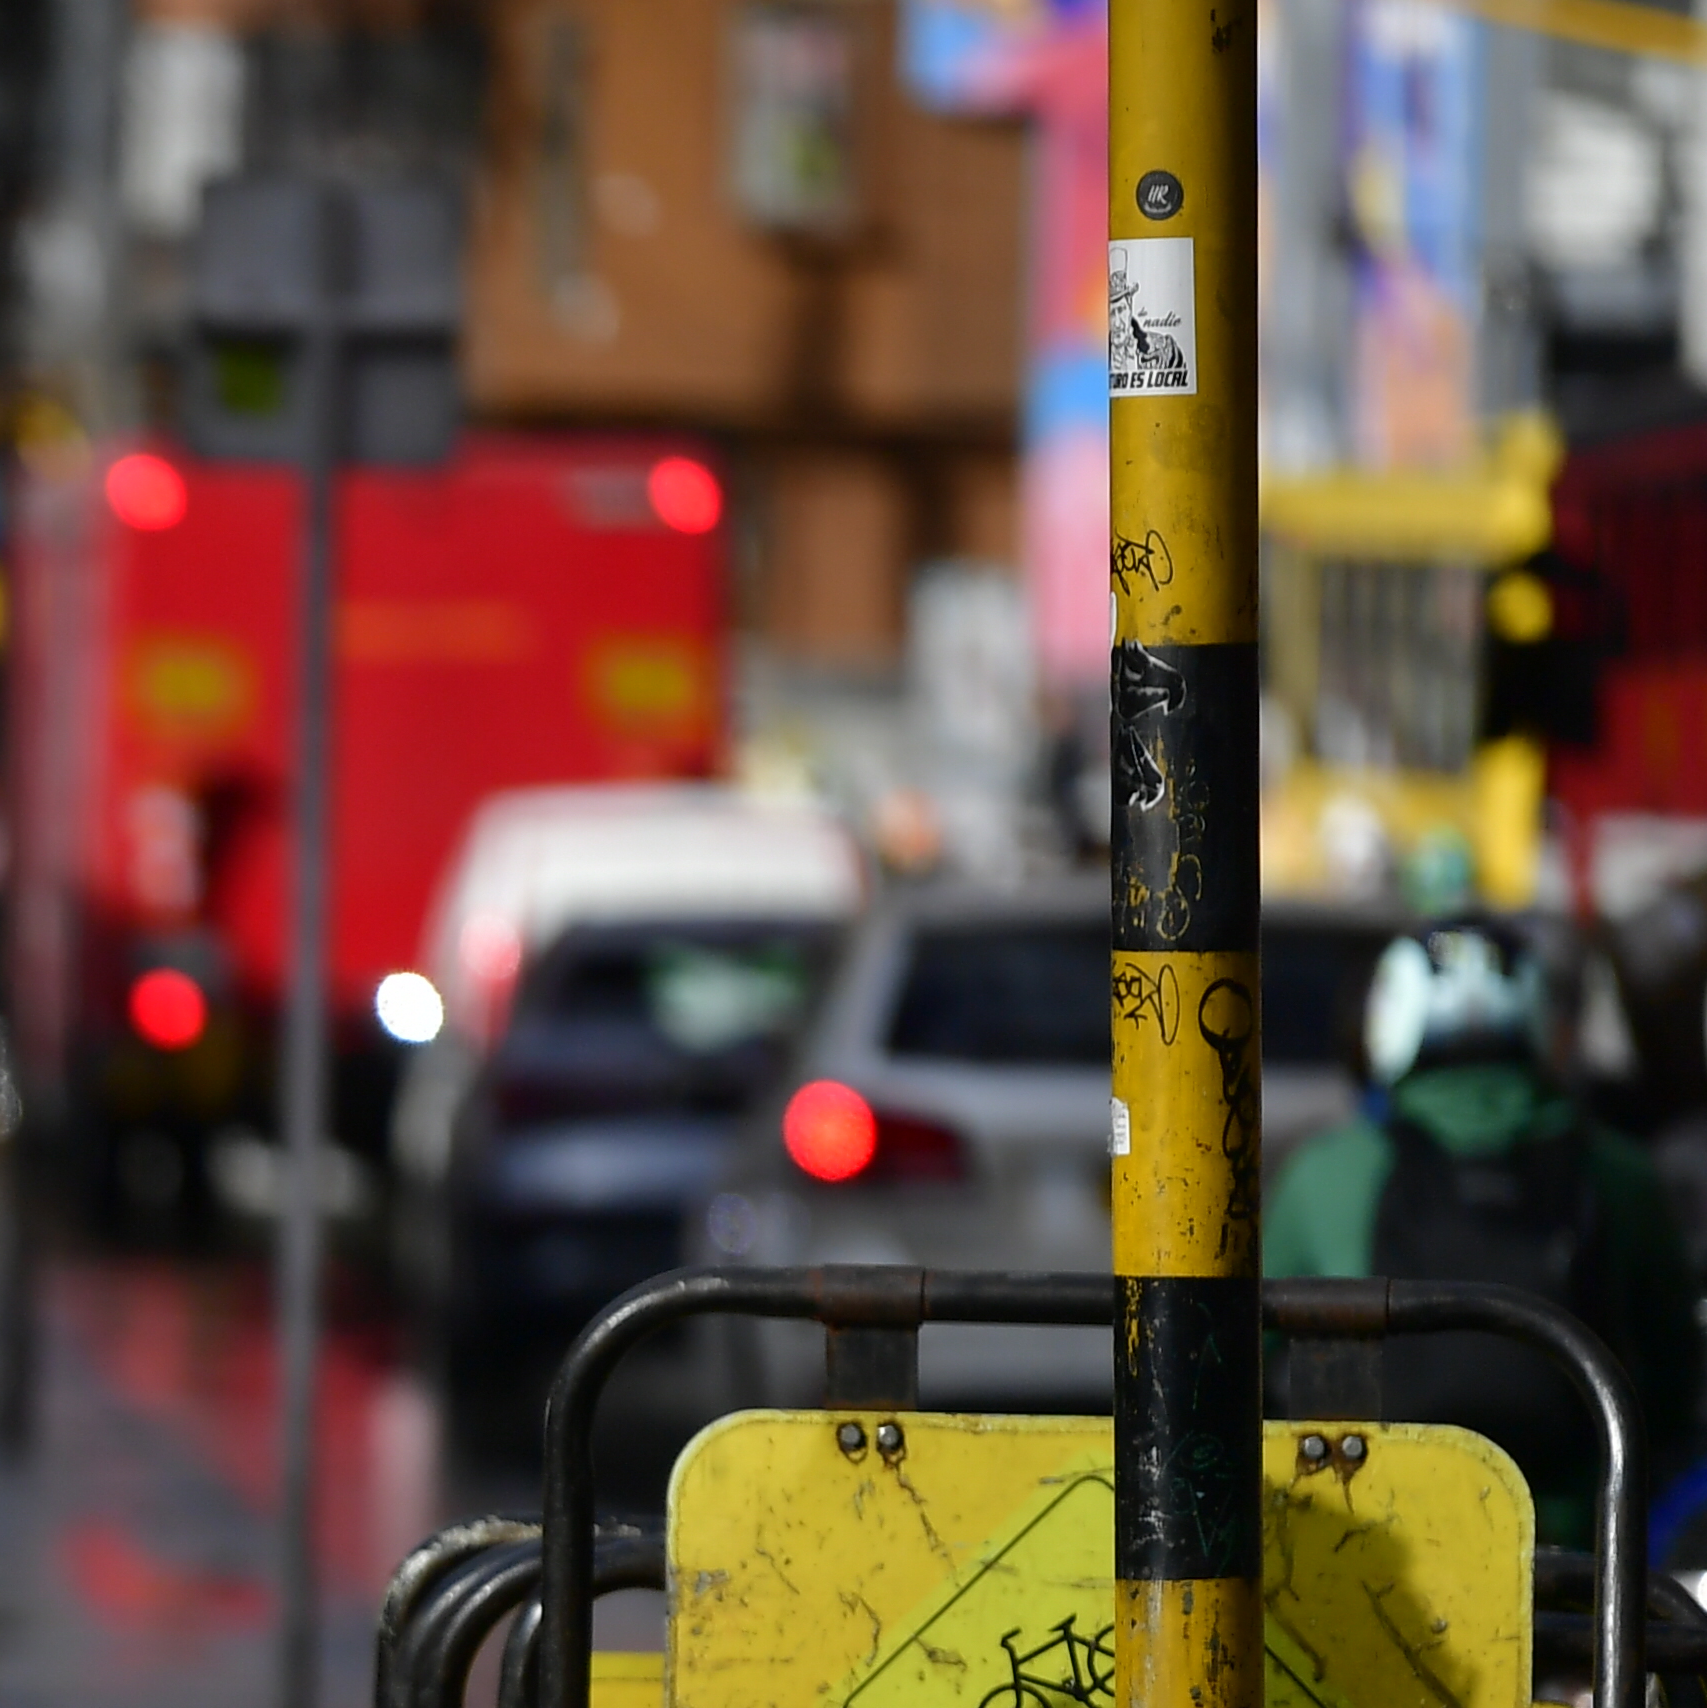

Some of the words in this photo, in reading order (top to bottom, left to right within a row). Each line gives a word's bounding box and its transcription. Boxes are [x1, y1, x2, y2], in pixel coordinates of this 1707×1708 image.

[1143, 311, 1182, 328] nadie
[1130, 371, 1145, 389] ES
[1147, 370, 1189, 388] LOCAL
